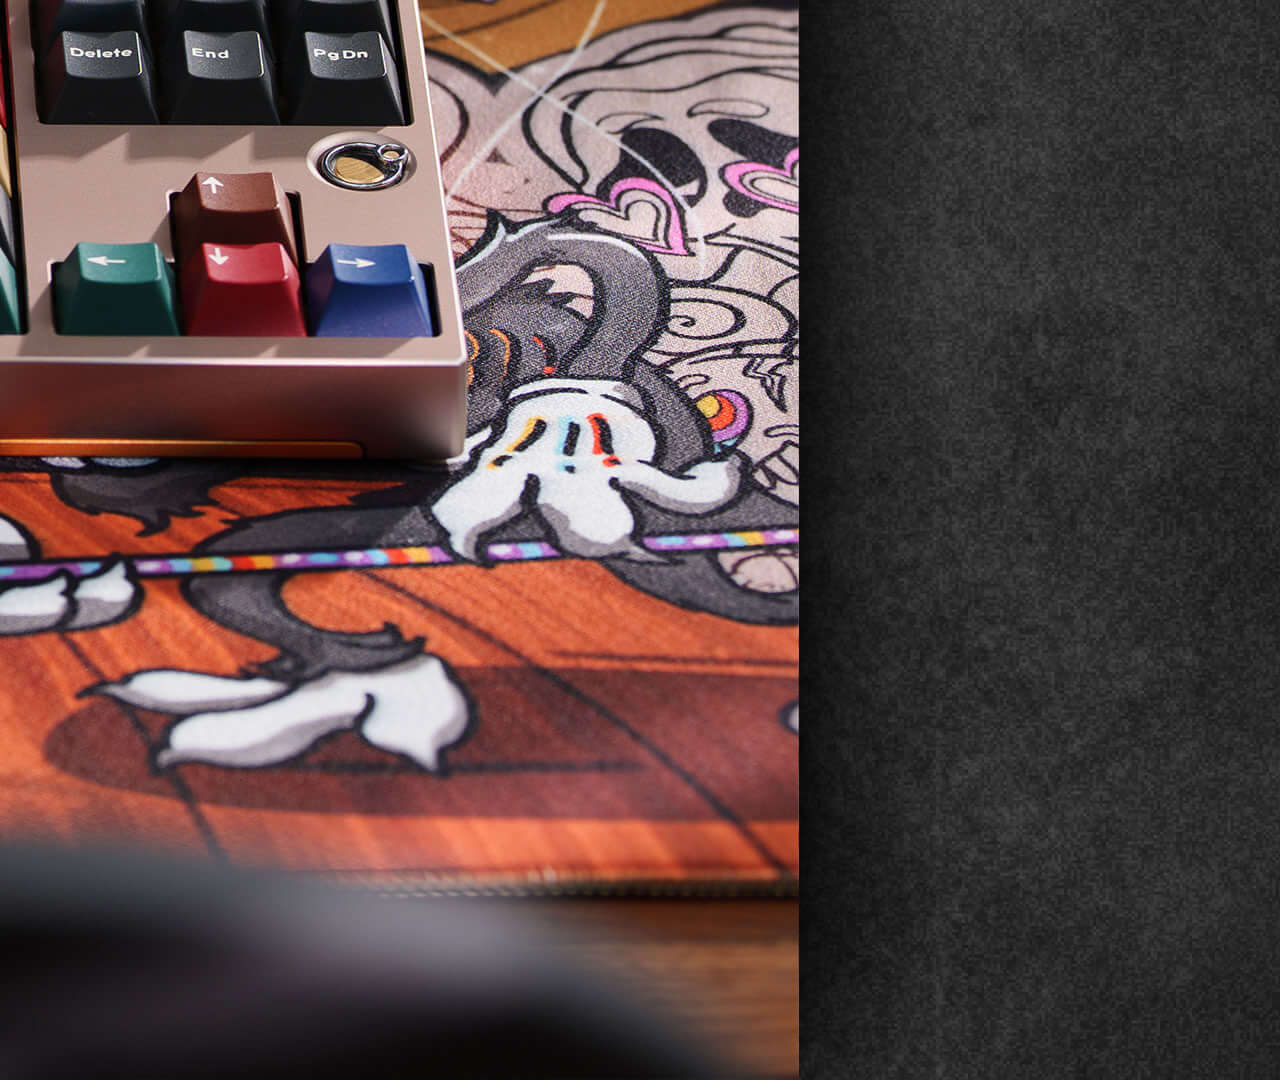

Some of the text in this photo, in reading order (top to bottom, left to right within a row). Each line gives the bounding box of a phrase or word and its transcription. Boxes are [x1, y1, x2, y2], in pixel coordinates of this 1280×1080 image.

[69, 46, 133, 60] Delete
[191, 47, 229, 61] End
[311, 46, 369, 61] PgDn
